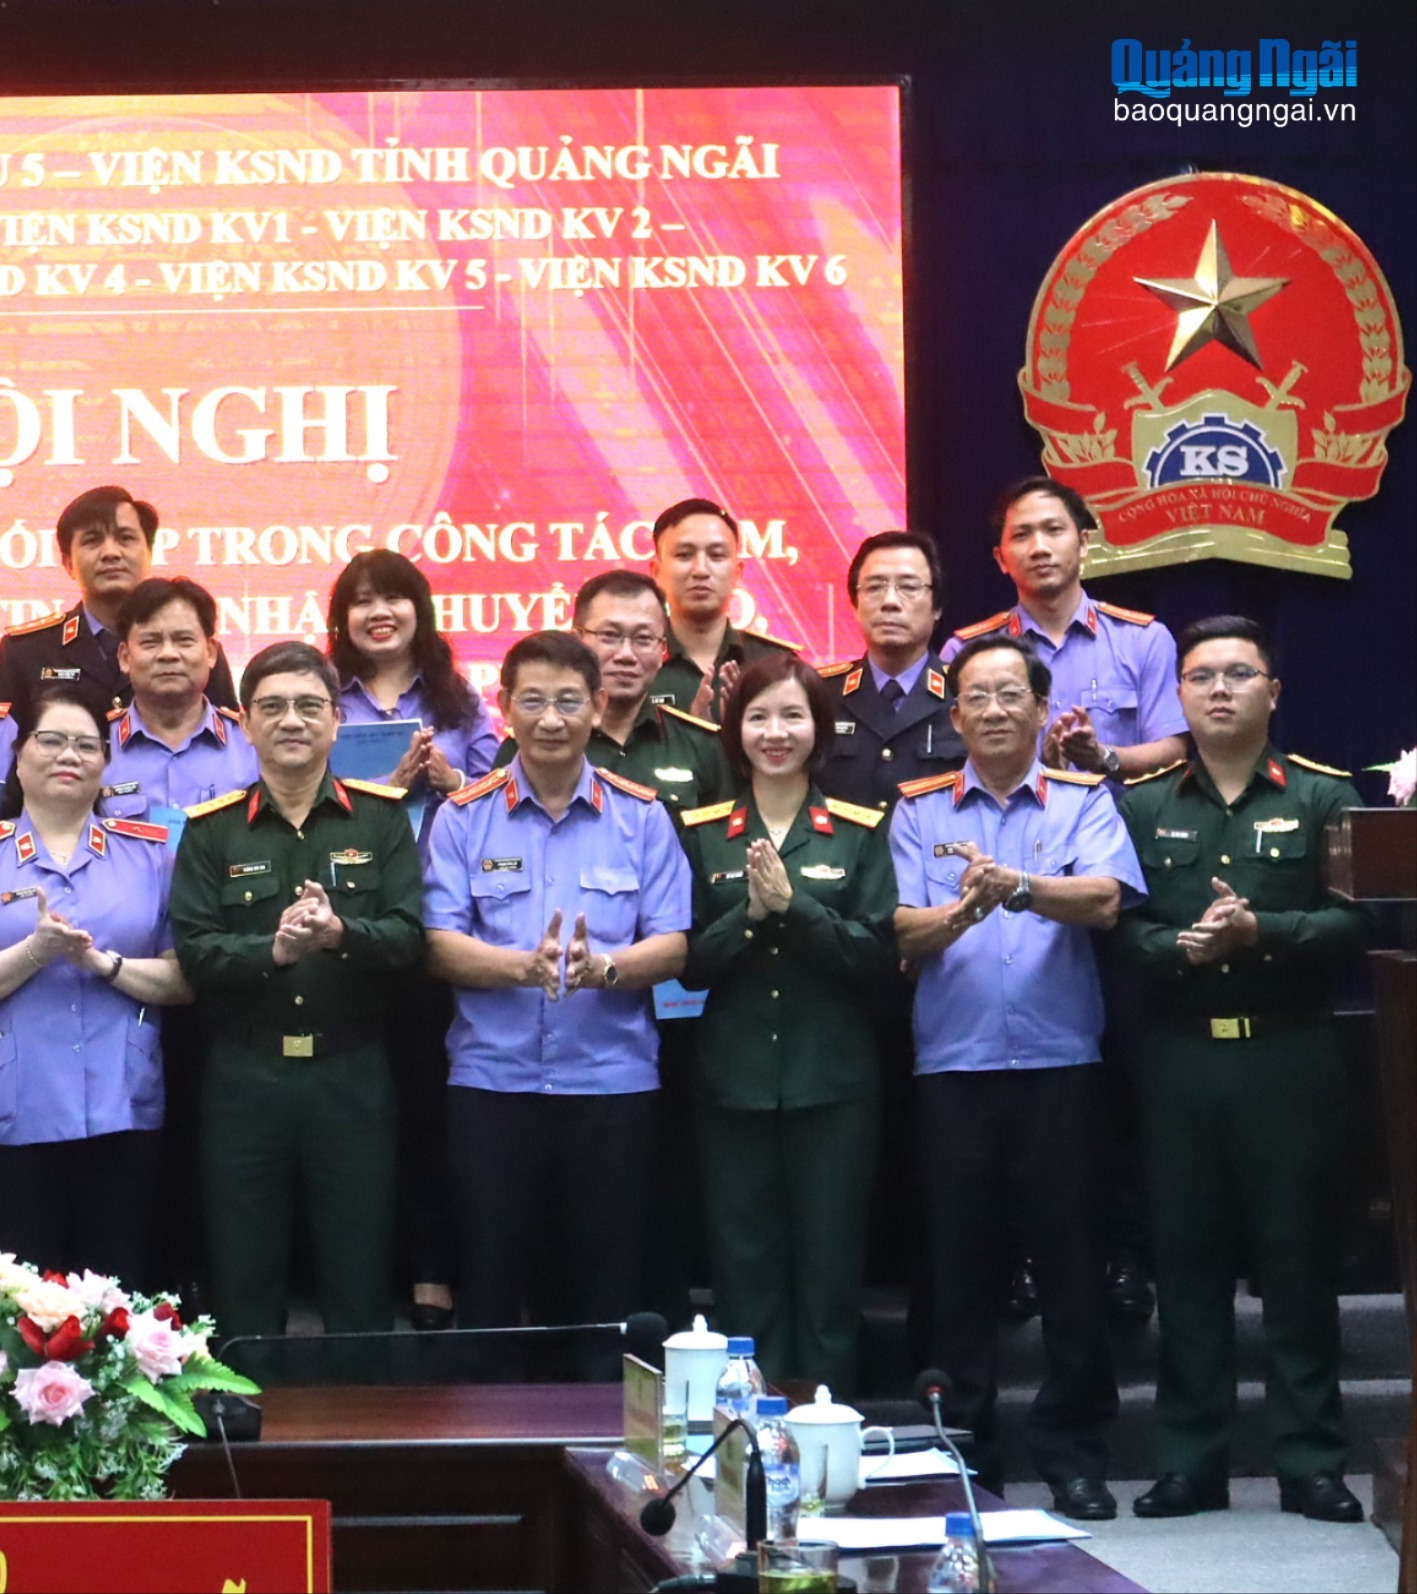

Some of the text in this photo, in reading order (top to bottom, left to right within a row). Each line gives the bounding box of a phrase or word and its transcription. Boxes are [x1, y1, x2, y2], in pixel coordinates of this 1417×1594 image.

[22, 153, 45, 187] 5
[88, 147, 202, 193] VIỆN
[216, 149, 343, 185] KSND
[352, 137, 469, 183] TỈNH
[478, 136, 650, 188] QUẢNG
[662, 137, 779, 179] NGÃI
[86, 211, 203, 246] KSND
[211, 212, 291, 244] KV1
[325, 207, 427, 250] VIỆN
[439, 207, 552, 241] KSND
[563, 208, 622, 240] KV
[633, 207, 651, 238] 2
[36, 264, 98, 296] KV
[106, 264, 127, 295] 4
[159, 260, 263, 302] VIỆN
[272, 260, 388, 293] KSND
[396, 260, 457, 291] KV
[467, 259, 487, 290] 5
[521, 257, 620, 299] VIỆN
[634, 256, 746, 288] KSND
[758, 256, 817, 287] KV
[825, 255, 847, 286] 6
[112, 382, 399, 483] NGHỊ
[1181, 445, 1249, 477] KS
[1118, 499, 1155, 523] CỘNG
[1164, 501, 1267, 526] VIỆT NAM
[187, 525, 375, 567] TRONG
[386, 511, 539, 564] CÔNG
[550, 512, 656, 561] TÁC
